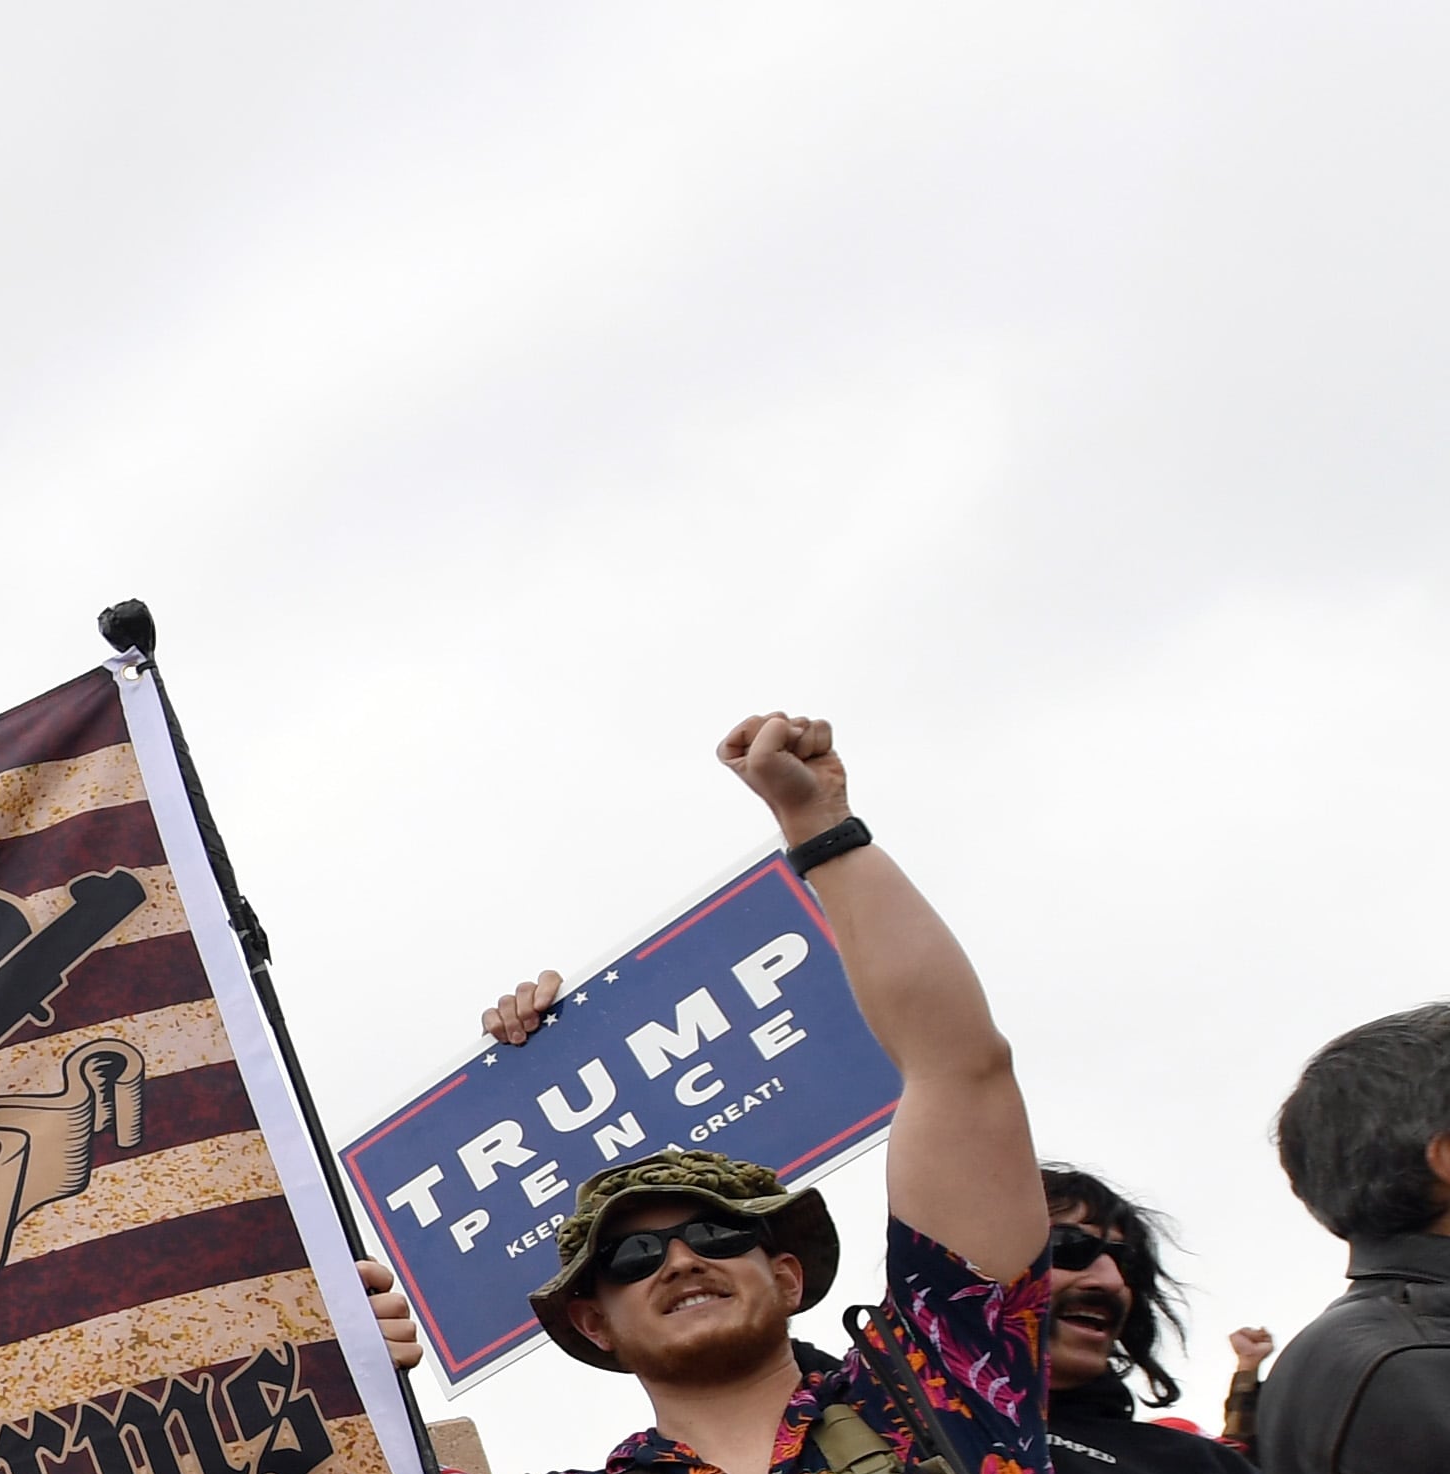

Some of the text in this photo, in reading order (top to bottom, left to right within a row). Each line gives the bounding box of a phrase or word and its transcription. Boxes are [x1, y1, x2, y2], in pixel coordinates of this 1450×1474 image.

[386, 932, 809, 1228] TRUMP
[450, 1010, 807, 1254] PENCE
[505, 1077, 785, 1259] KEEP GREAT!
